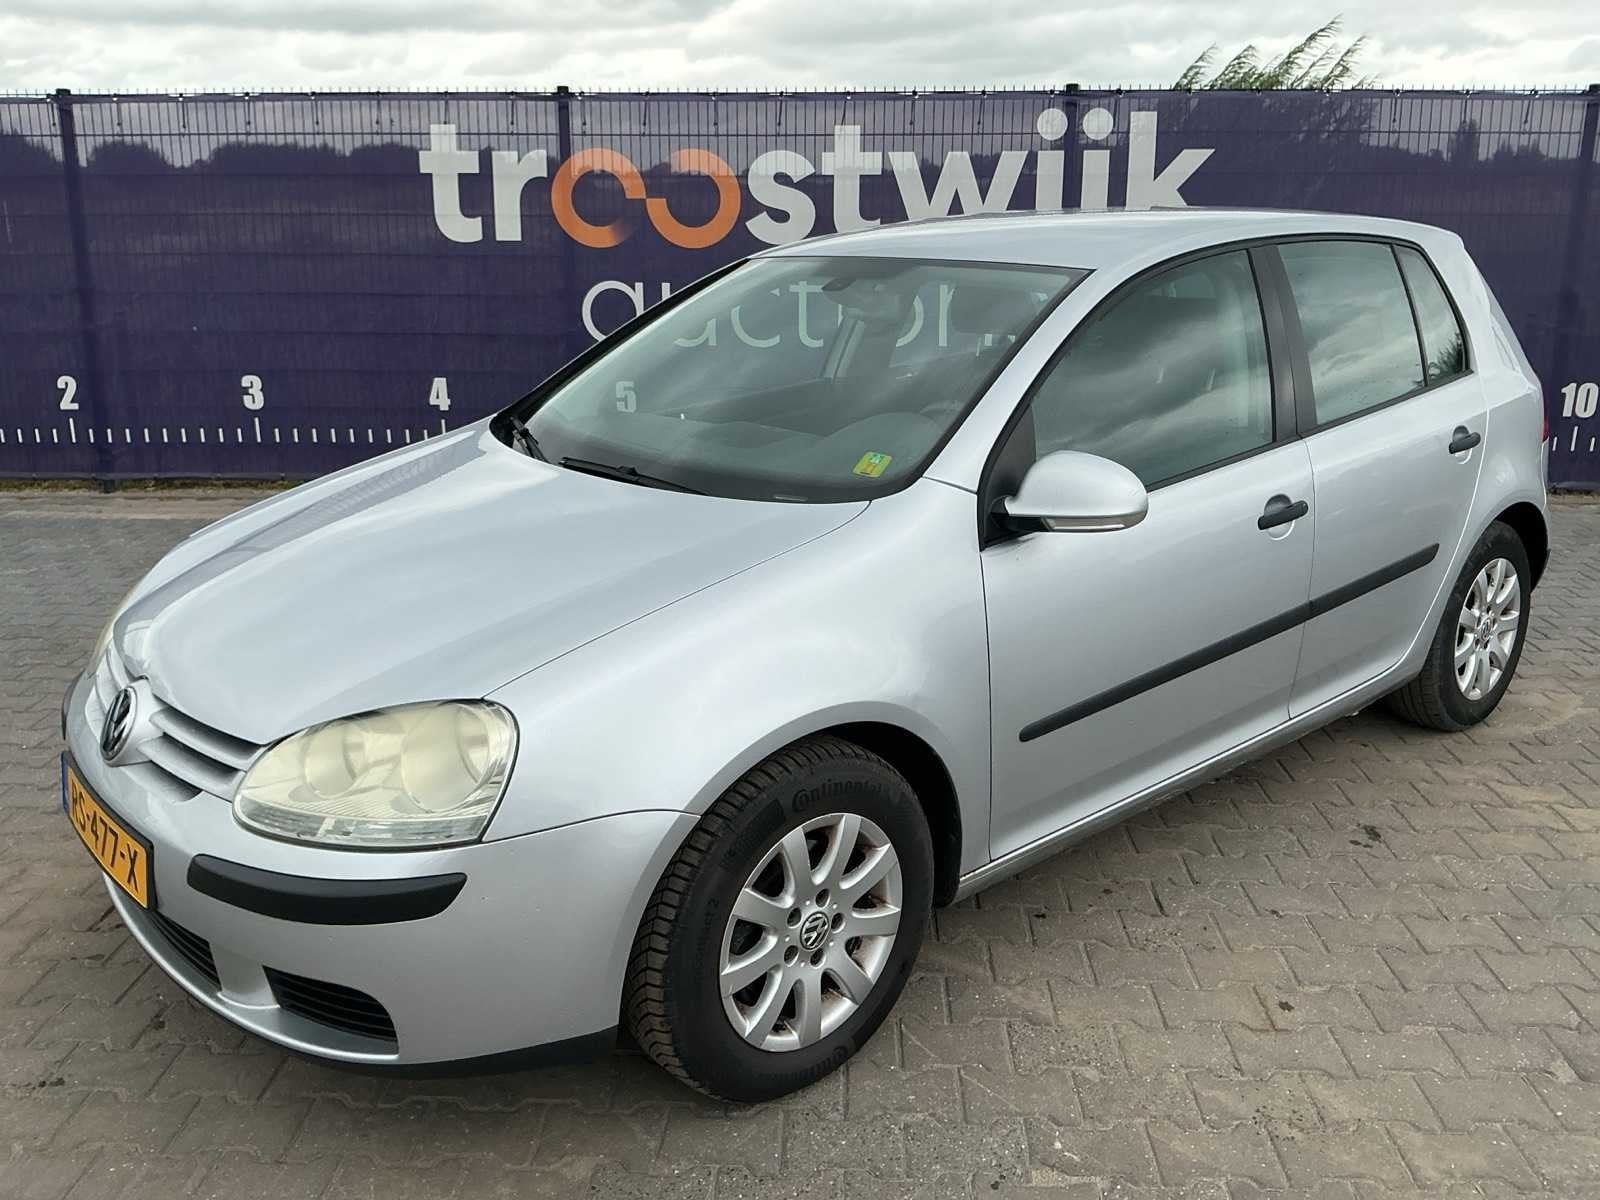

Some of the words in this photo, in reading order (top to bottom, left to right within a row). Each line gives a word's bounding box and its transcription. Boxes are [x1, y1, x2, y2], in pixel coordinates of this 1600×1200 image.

[419, 108, 1215, 248] troostwijk
[57, 375, 79, 411] 2
[241, 375, 265, 411] 3
[429, 377, 451, 411] 4
[615, 381, 637, 413] 5
[1561, 382, 1599, 418] 10
[71, 780, 140, 892] RS-477-X
